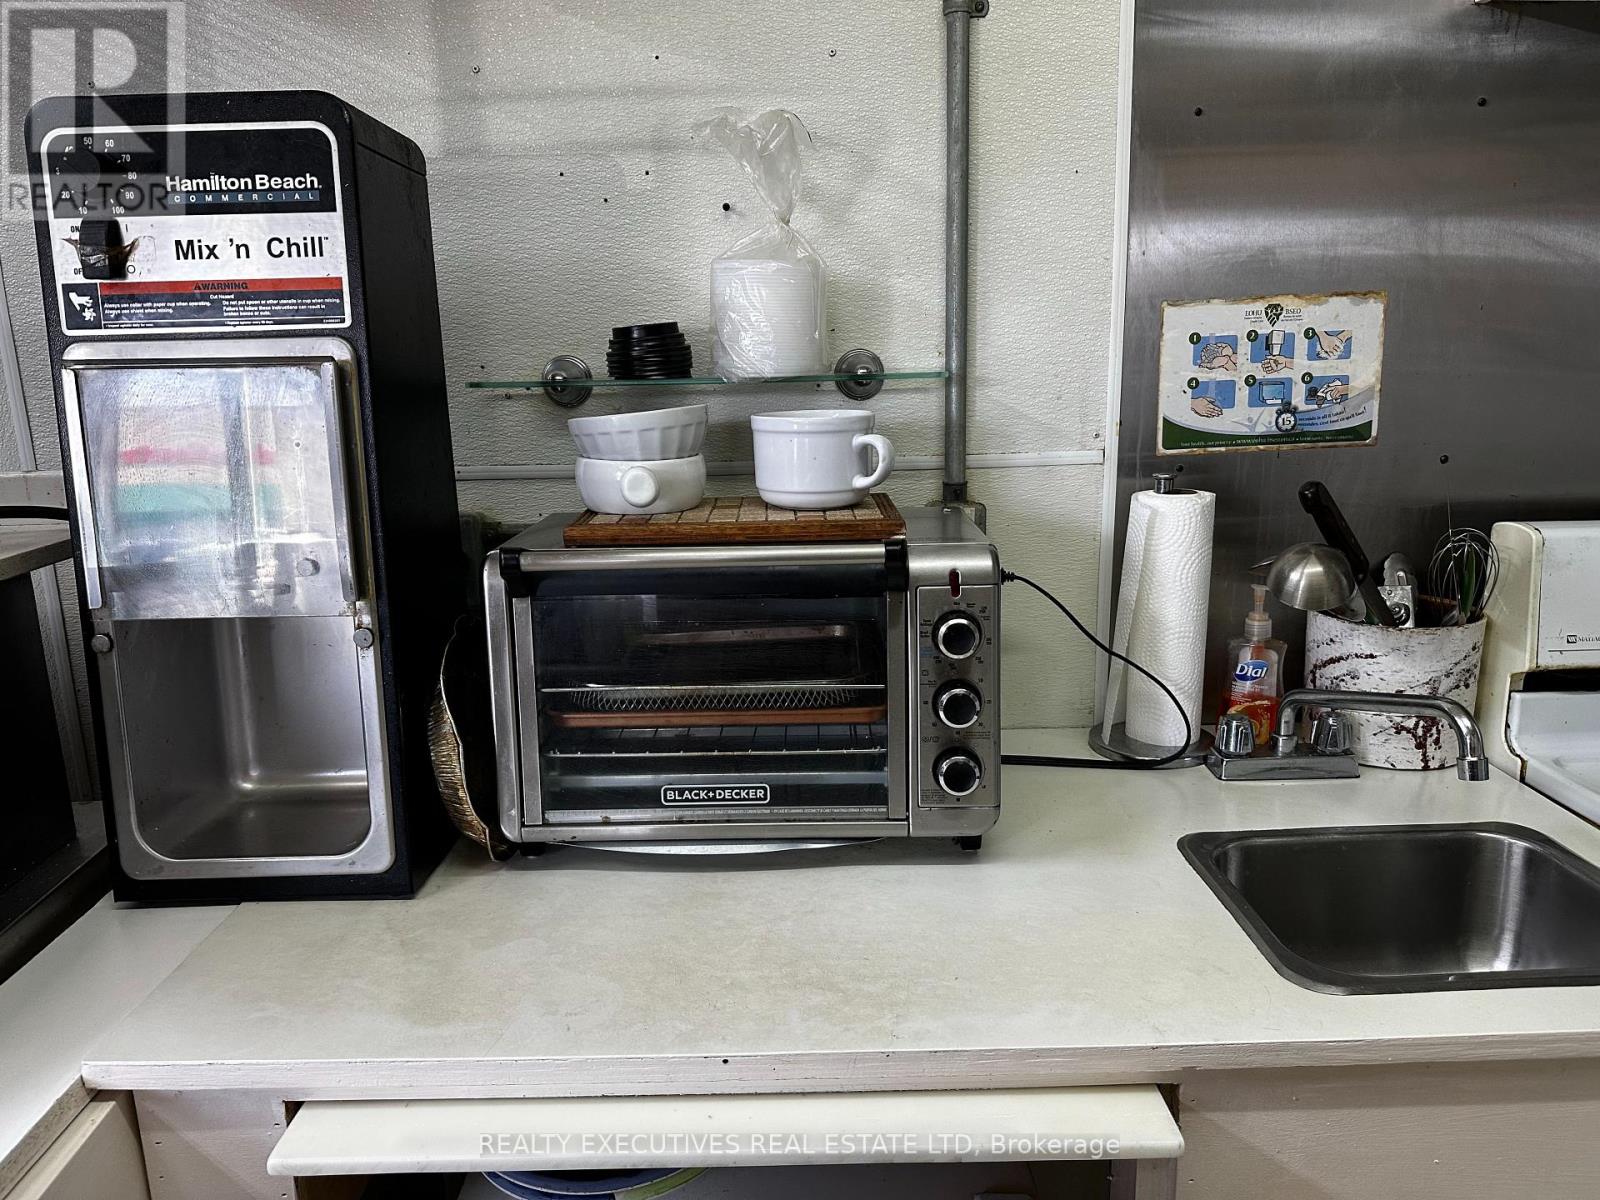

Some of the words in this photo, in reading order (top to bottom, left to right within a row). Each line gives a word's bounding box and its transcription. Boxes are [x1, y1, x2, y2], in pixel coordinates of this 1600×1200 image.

[83, 136, 93, 145] 50
[104, 139, 115, 148] 60
[121, 154, 131, 162] 70
[127, 171, 137, 180] 80
[165, 173, 252, 192] Hamilton
[61, 191, 71, 199] 20
[125, 191, 135, 200] 90
[174, 192, 314, 203] COMMERCIAL
[79, 206, 88, 215] 10
[111, 206, 125, 215] 100
[174, 238, 220, 261] Mix
[201, 281, 249, 290] WARNING
[1282, 416, 1292, 426] 15
[1235, 663, 1267, 678] Dial
[666, 788, 765, 800] BLACK+DECKER
